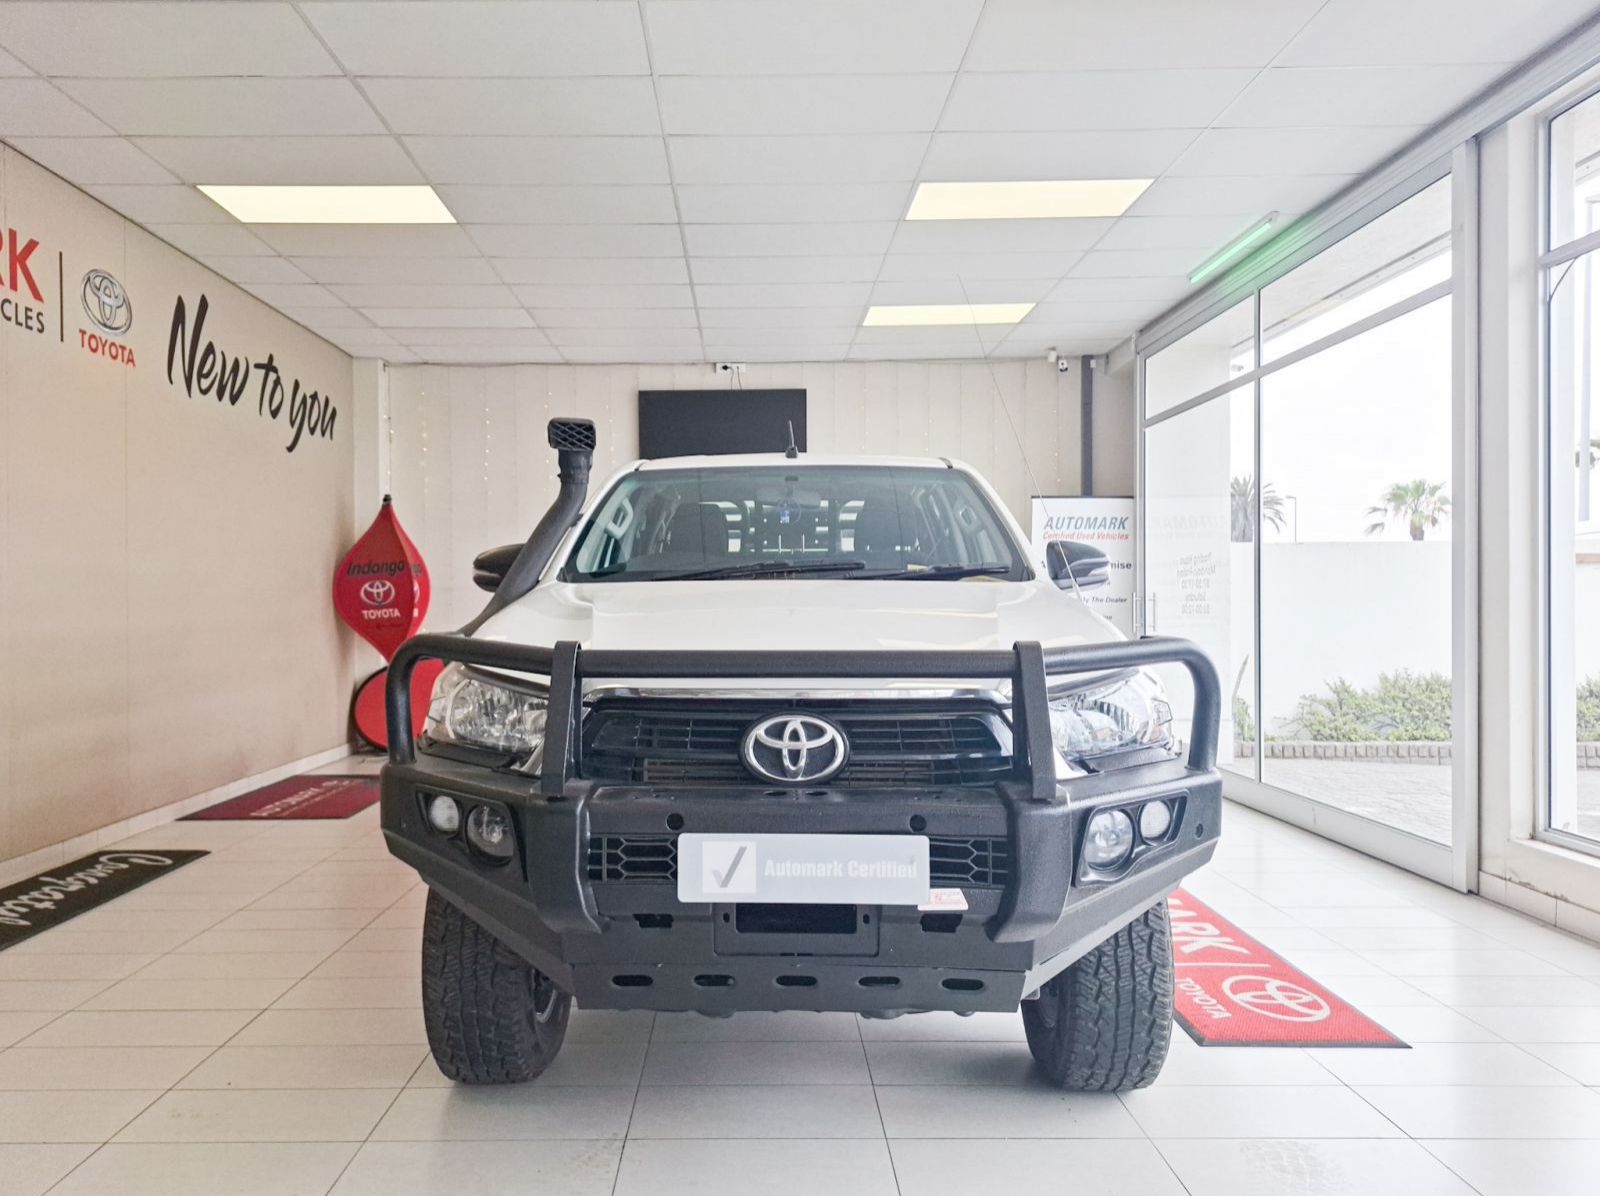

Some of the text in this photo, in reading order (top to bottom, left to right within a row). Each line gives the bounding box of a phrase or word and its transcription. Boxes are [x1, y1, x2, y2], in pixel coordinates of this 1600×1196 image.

[0, 227, 44, 304] K
[78, 328, 136, 367] TOYOTA
[167, 294, 337, 453] New to you
[1043, 516, 1129, 530] AUTOMARK
[1043, 531, 1129, 540] Certified Used Vehicles
[346, 560, 406, 577] Indongo
[362, 608, 401, 619] TOYOTA
[764, 858, 918, 880] Automark Certified
[1174, 976, 1233, 1020] TOYOTA
